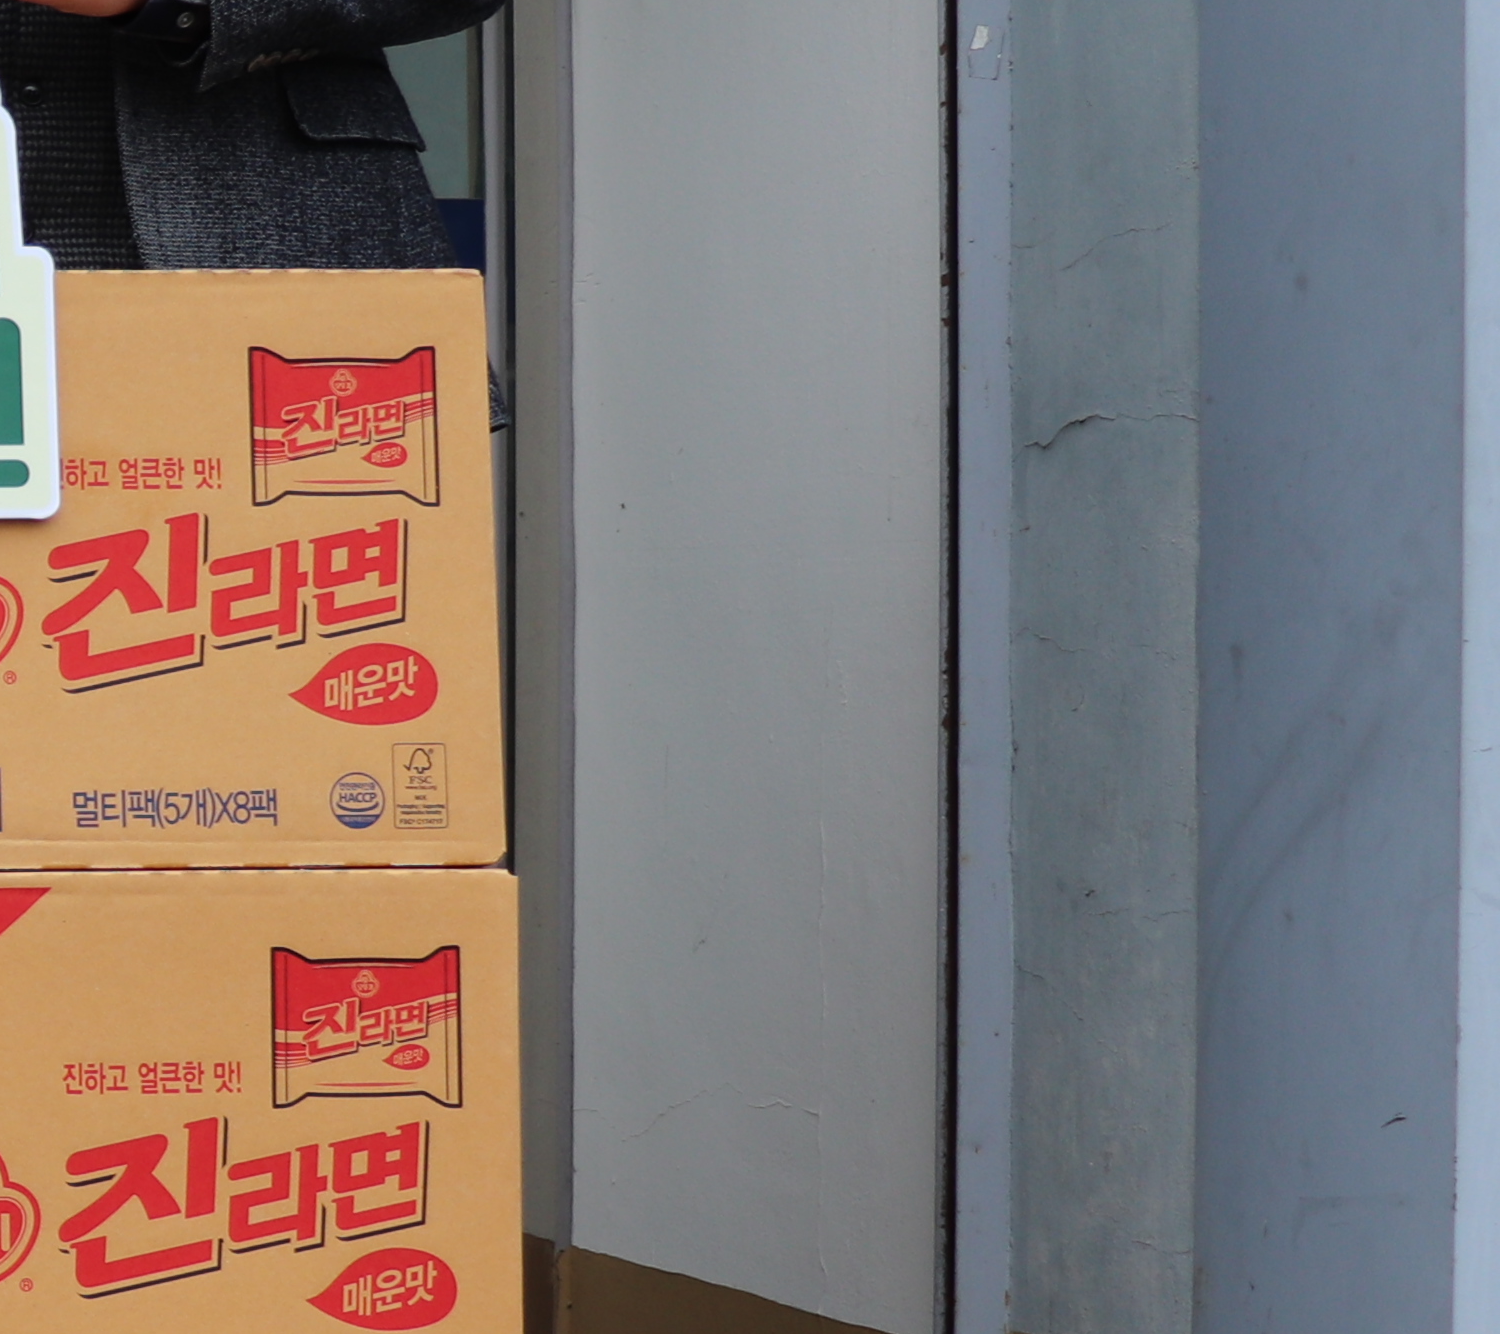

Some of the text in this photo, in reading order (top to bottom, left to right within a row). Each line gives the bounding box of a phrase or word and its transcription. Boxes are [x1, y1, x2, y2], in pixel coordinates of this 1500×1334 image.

[60, 458, 109, 490] 하고
[118, 458, 185, 490] 얼큰한
[41, 512, 410, 694] 진라면
[324, 656, 419, 712] 매운맛
[58, 1116, 430, 1299] 진라면
[342, 1261, 438, 1317] 매운맛
